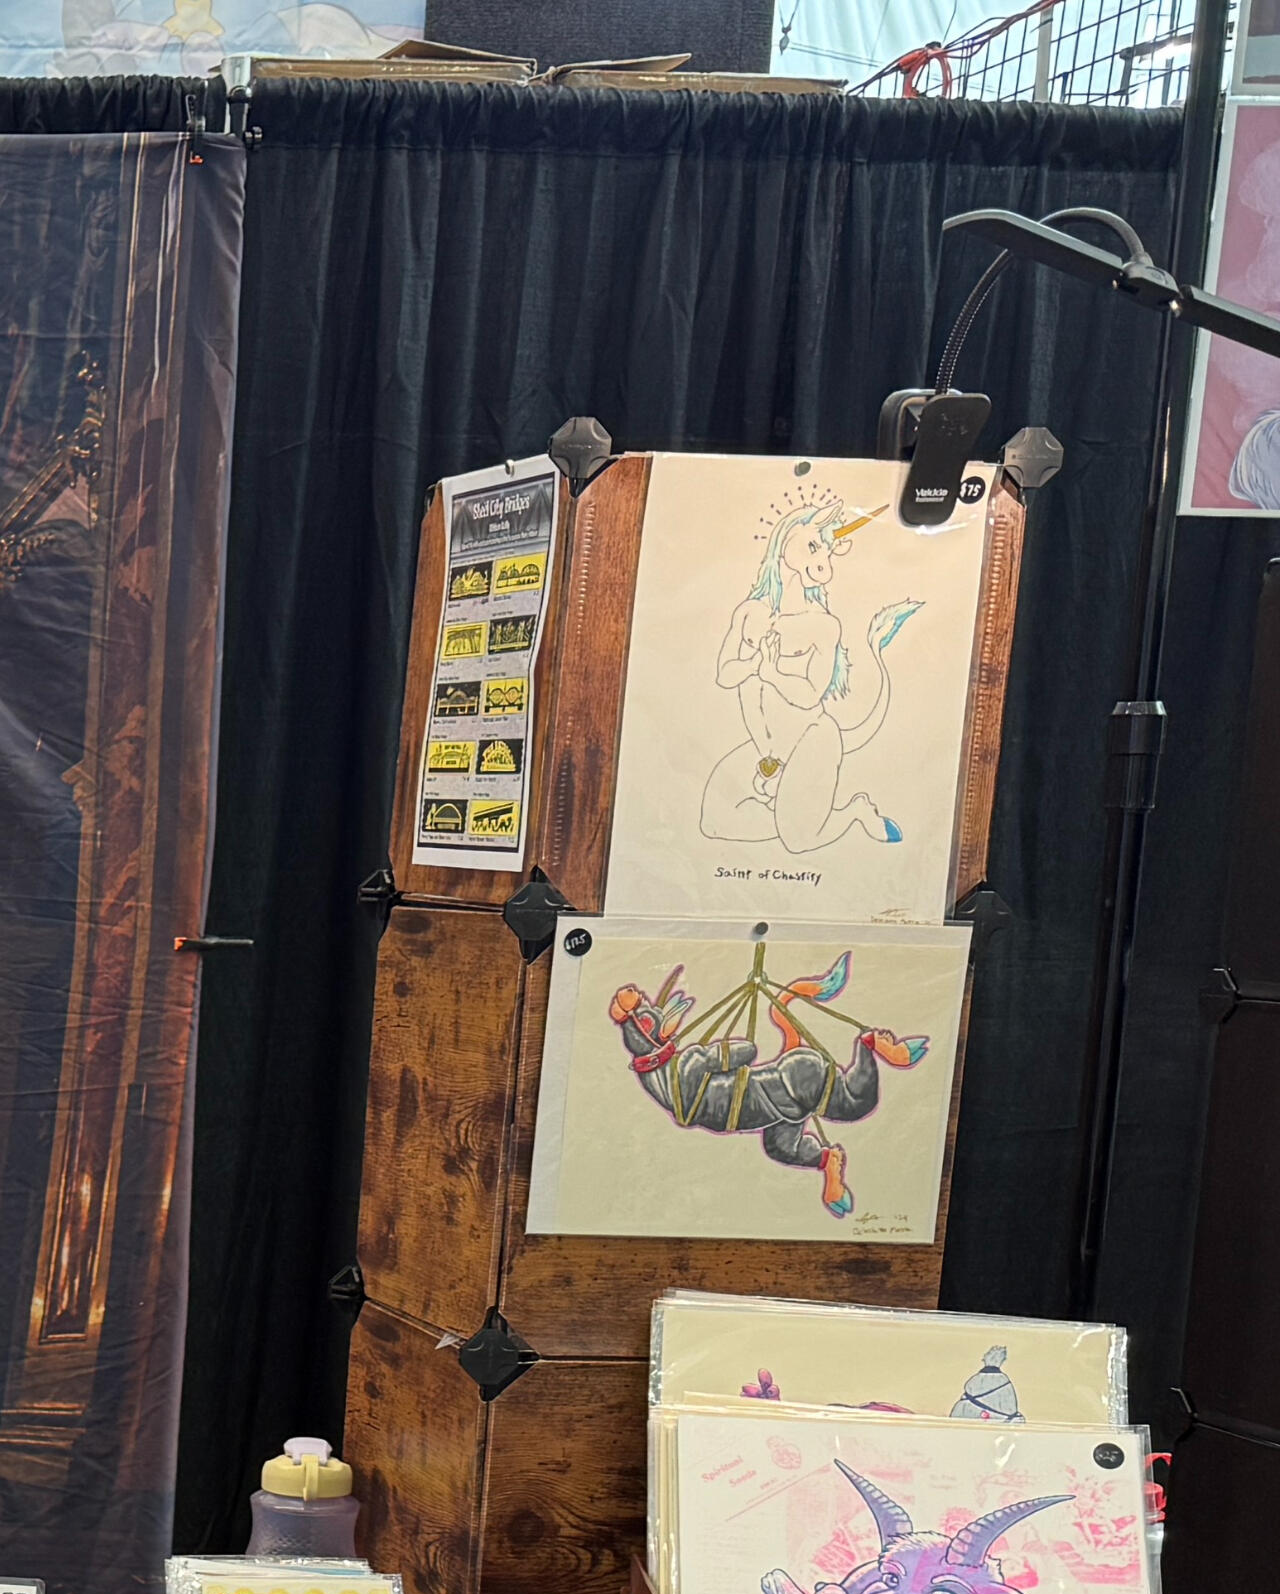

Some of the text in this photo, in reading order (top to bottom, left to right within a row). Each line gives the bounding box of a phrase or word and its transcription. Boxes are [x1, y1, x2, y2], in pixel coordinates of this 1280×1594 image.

[959, 483, 982, 498] $75
[490, 496, 504, 519] City
[504, 493, 531, 517] Bridges
[714, 866, 822, 887] Saint of Chastity
